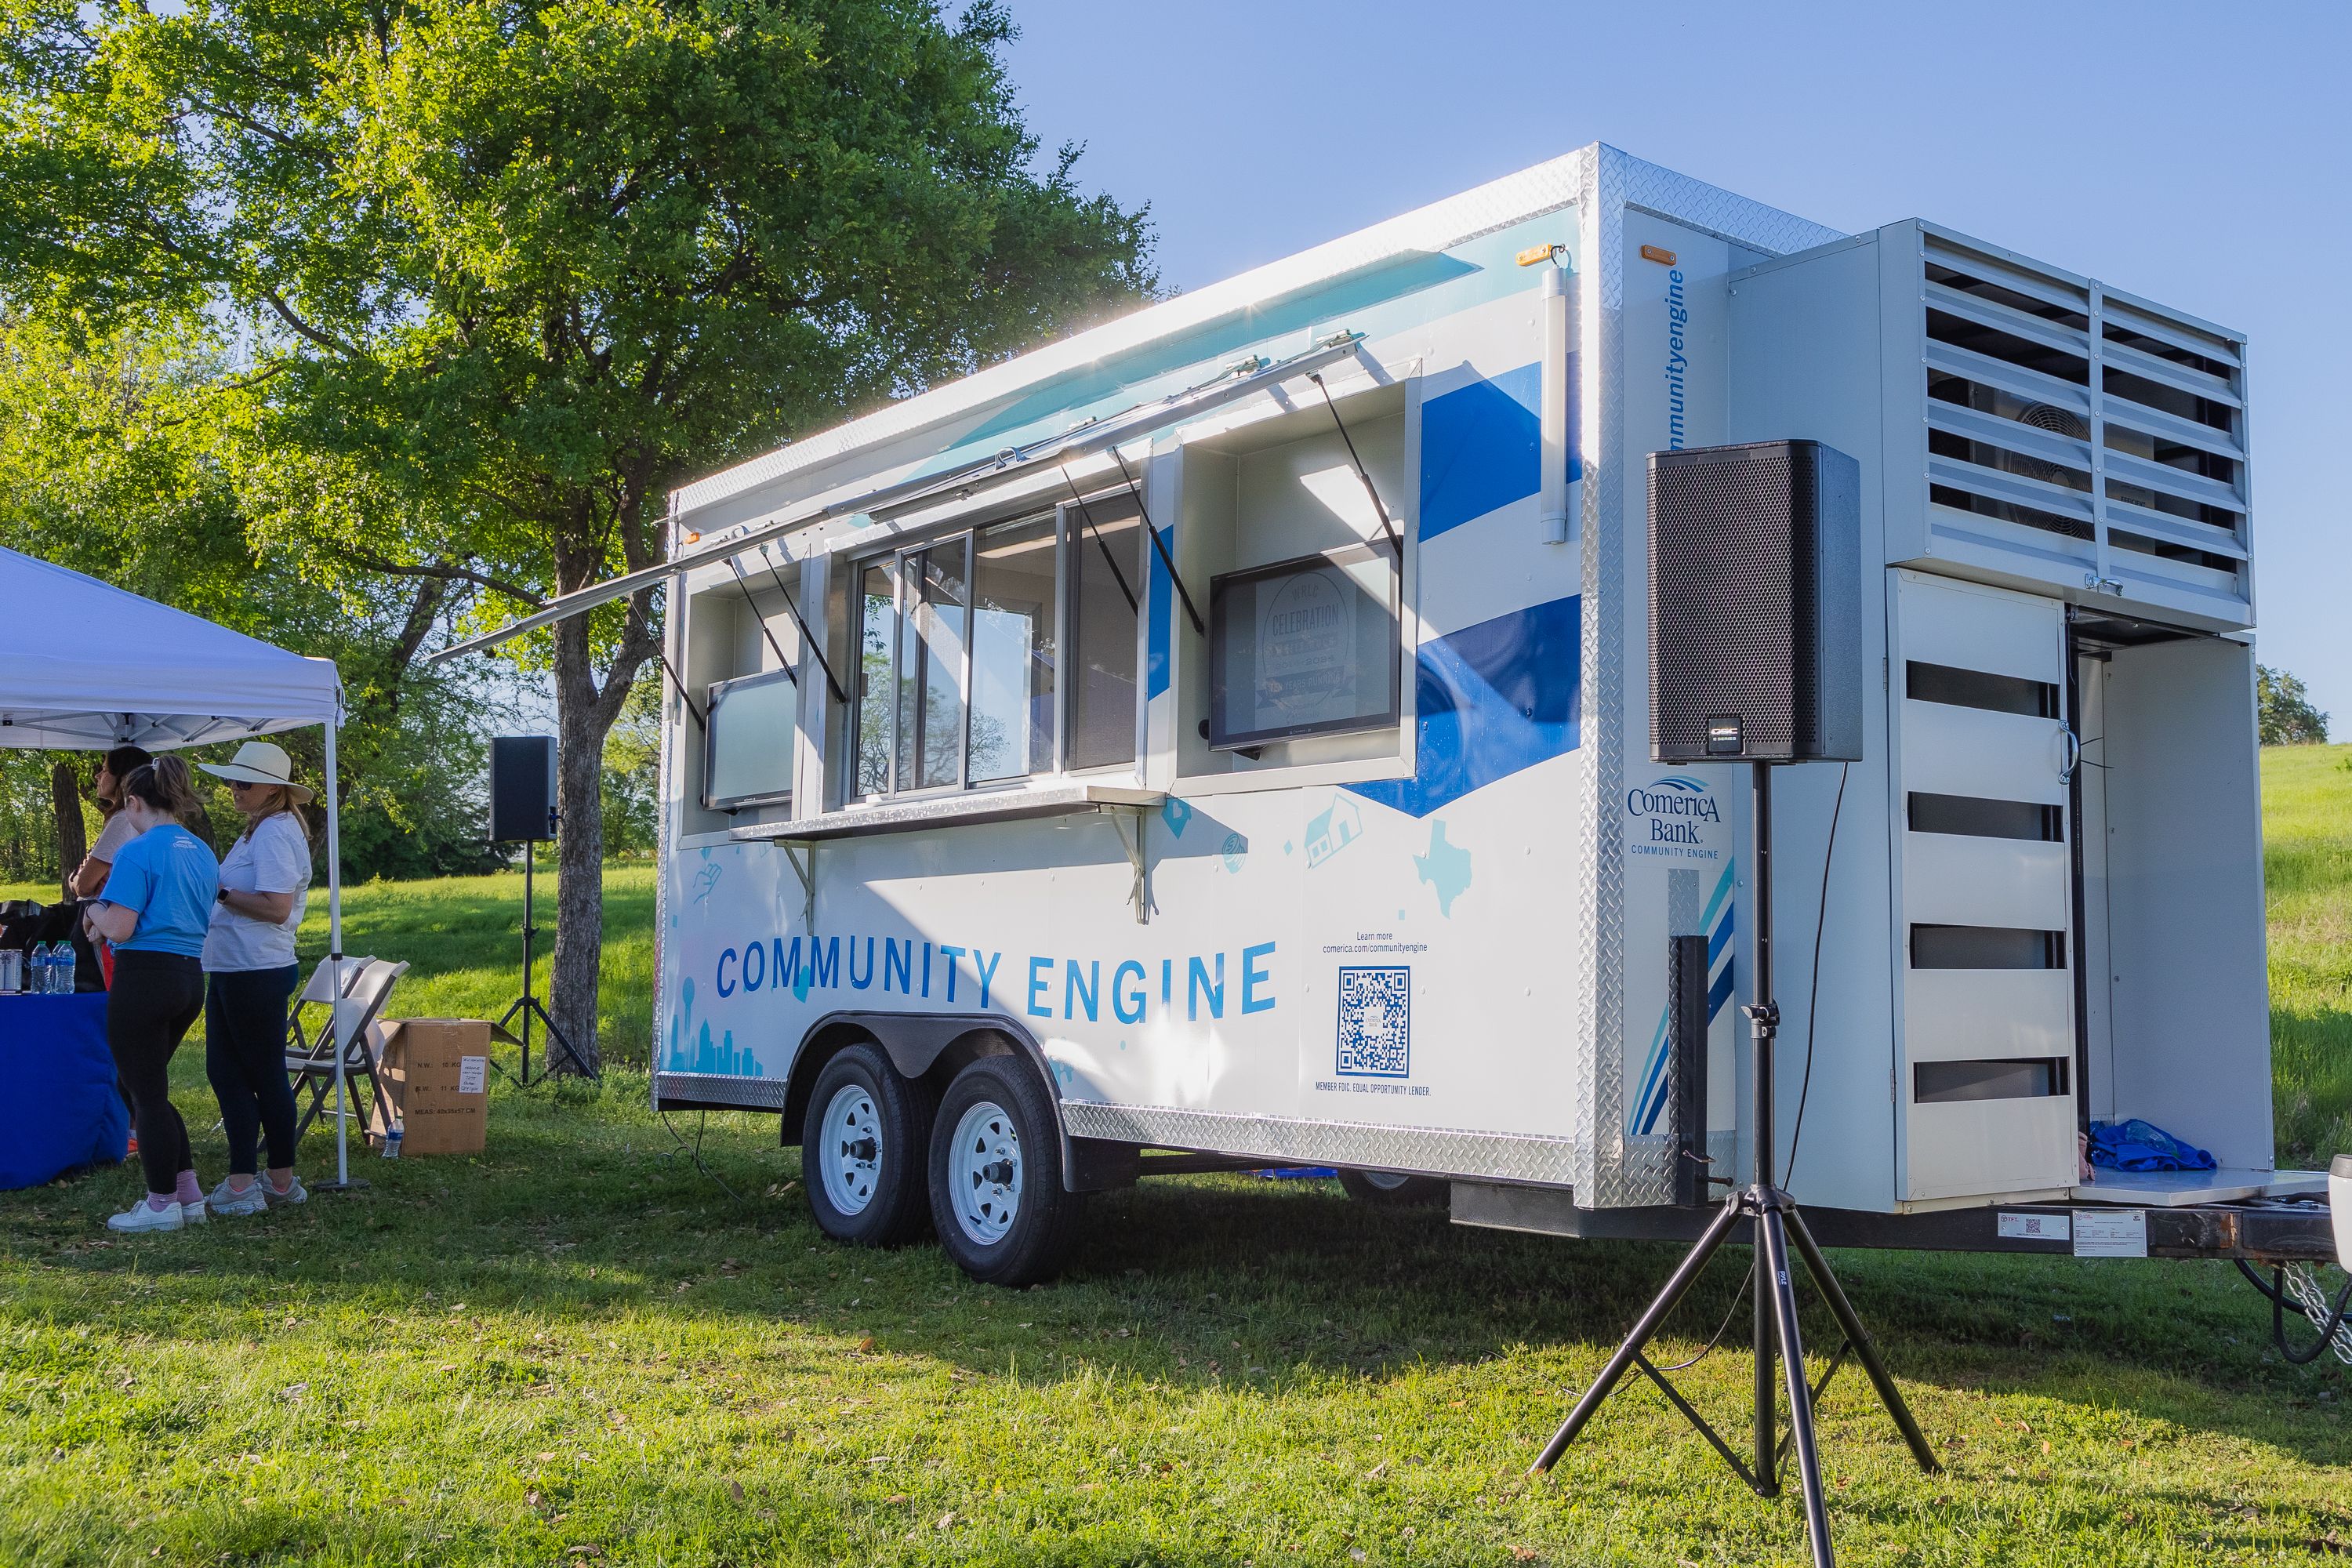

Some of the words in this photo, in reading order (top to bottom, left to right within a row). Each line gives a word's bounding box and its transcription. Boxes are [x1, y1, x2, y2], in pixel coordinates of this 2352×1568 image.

[1665, 269, 1687, 451] mmunityengine
[1272, 603, 1339, 637] CELEBRATION
[1631, 844, 1684, 858] COMMUNITY
[1687, 848, 1719, 859] ENGINE
[1356, 931, 1375, 941] Learn
[1323, 942, 1428, 954] comerica.com/communityengine
[717, 935, 1002, 1009] COMMUNITY
[1027, 941, 1276, 1025] ENGINE
[1316, 1081, 1338, 1091] MEMBER
[1338, 1082, 1352, 1092] FDIC.
[1352, 1083, 1369, 1094] EQUAL
[1370, 1083, 1407, 1095] OPPORTUNITY
[1408, 1086, 1432, 1097] LENDER.
